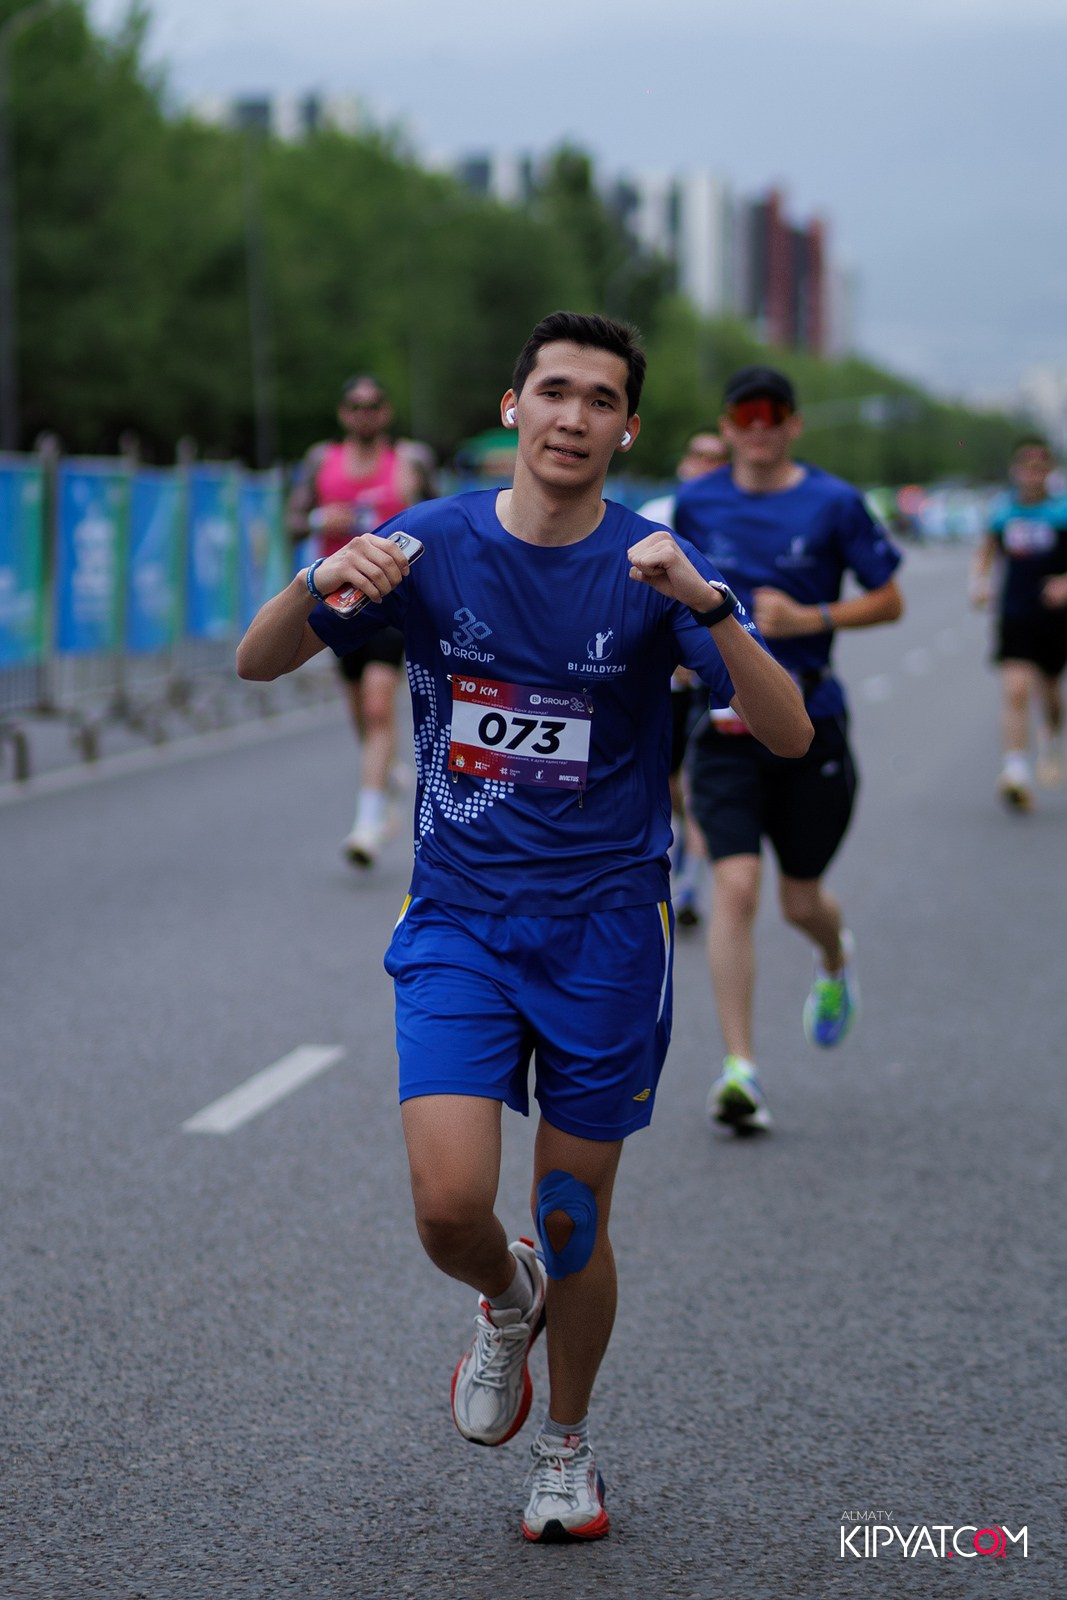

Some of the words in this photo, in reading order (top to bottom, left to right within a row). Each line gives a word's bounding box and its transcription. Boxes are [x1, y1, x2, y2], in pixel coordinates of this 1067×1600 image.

[453, 646, 496, 663] GROUP
[567, 662, 578, 671] BI
[460, 680, 477, 693] 10
[479, 686, 499, 697] KM
[542, 697, 570, 706] GROUP
[478, 712, 567, 755] 073
